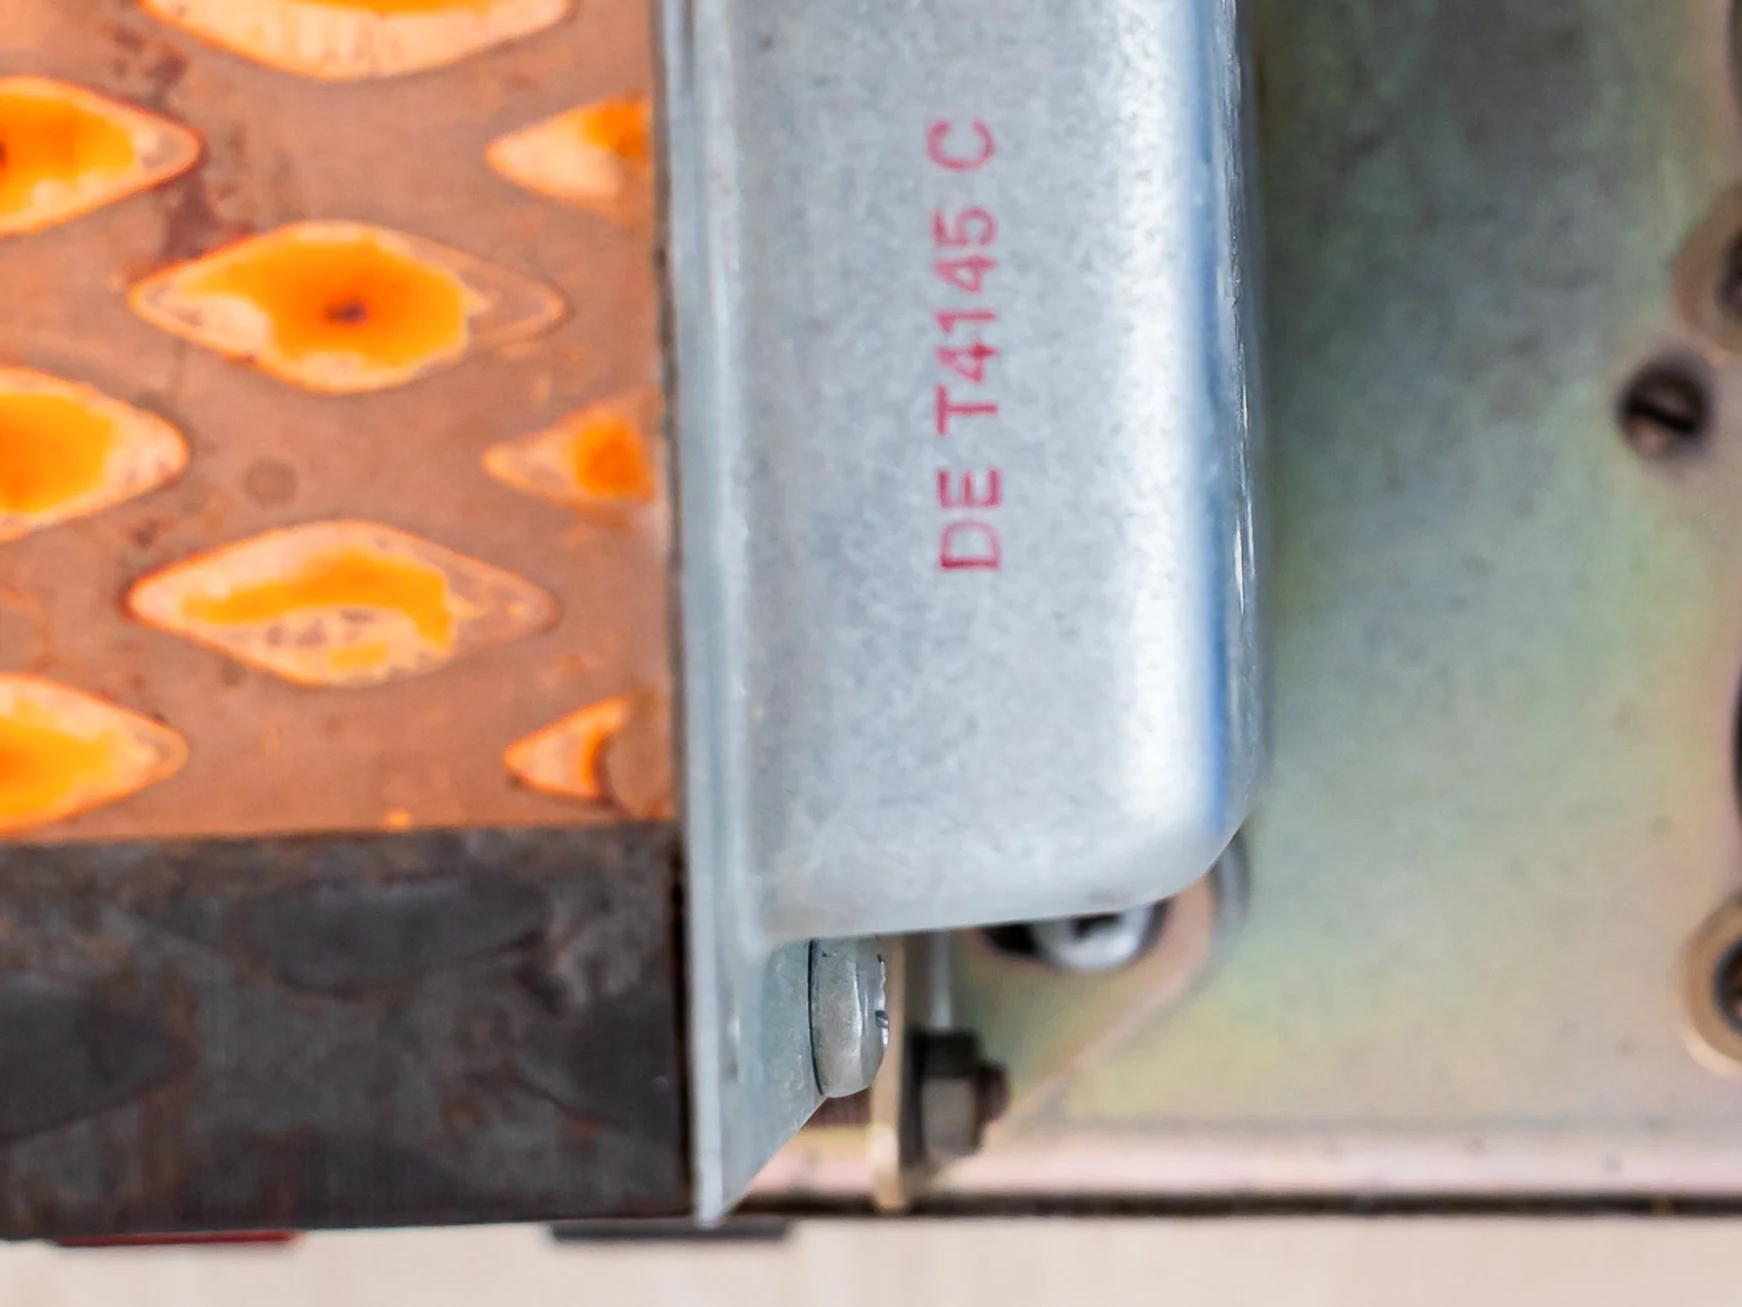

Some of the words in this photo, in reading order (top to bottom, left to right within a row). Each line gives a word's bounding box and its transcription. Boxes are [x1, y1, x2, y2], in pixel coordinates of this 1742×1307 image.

[924, 118, 997, 172] C
[932, 206, 999, 438] T4145
[935, 467, 1004, 572] DE
